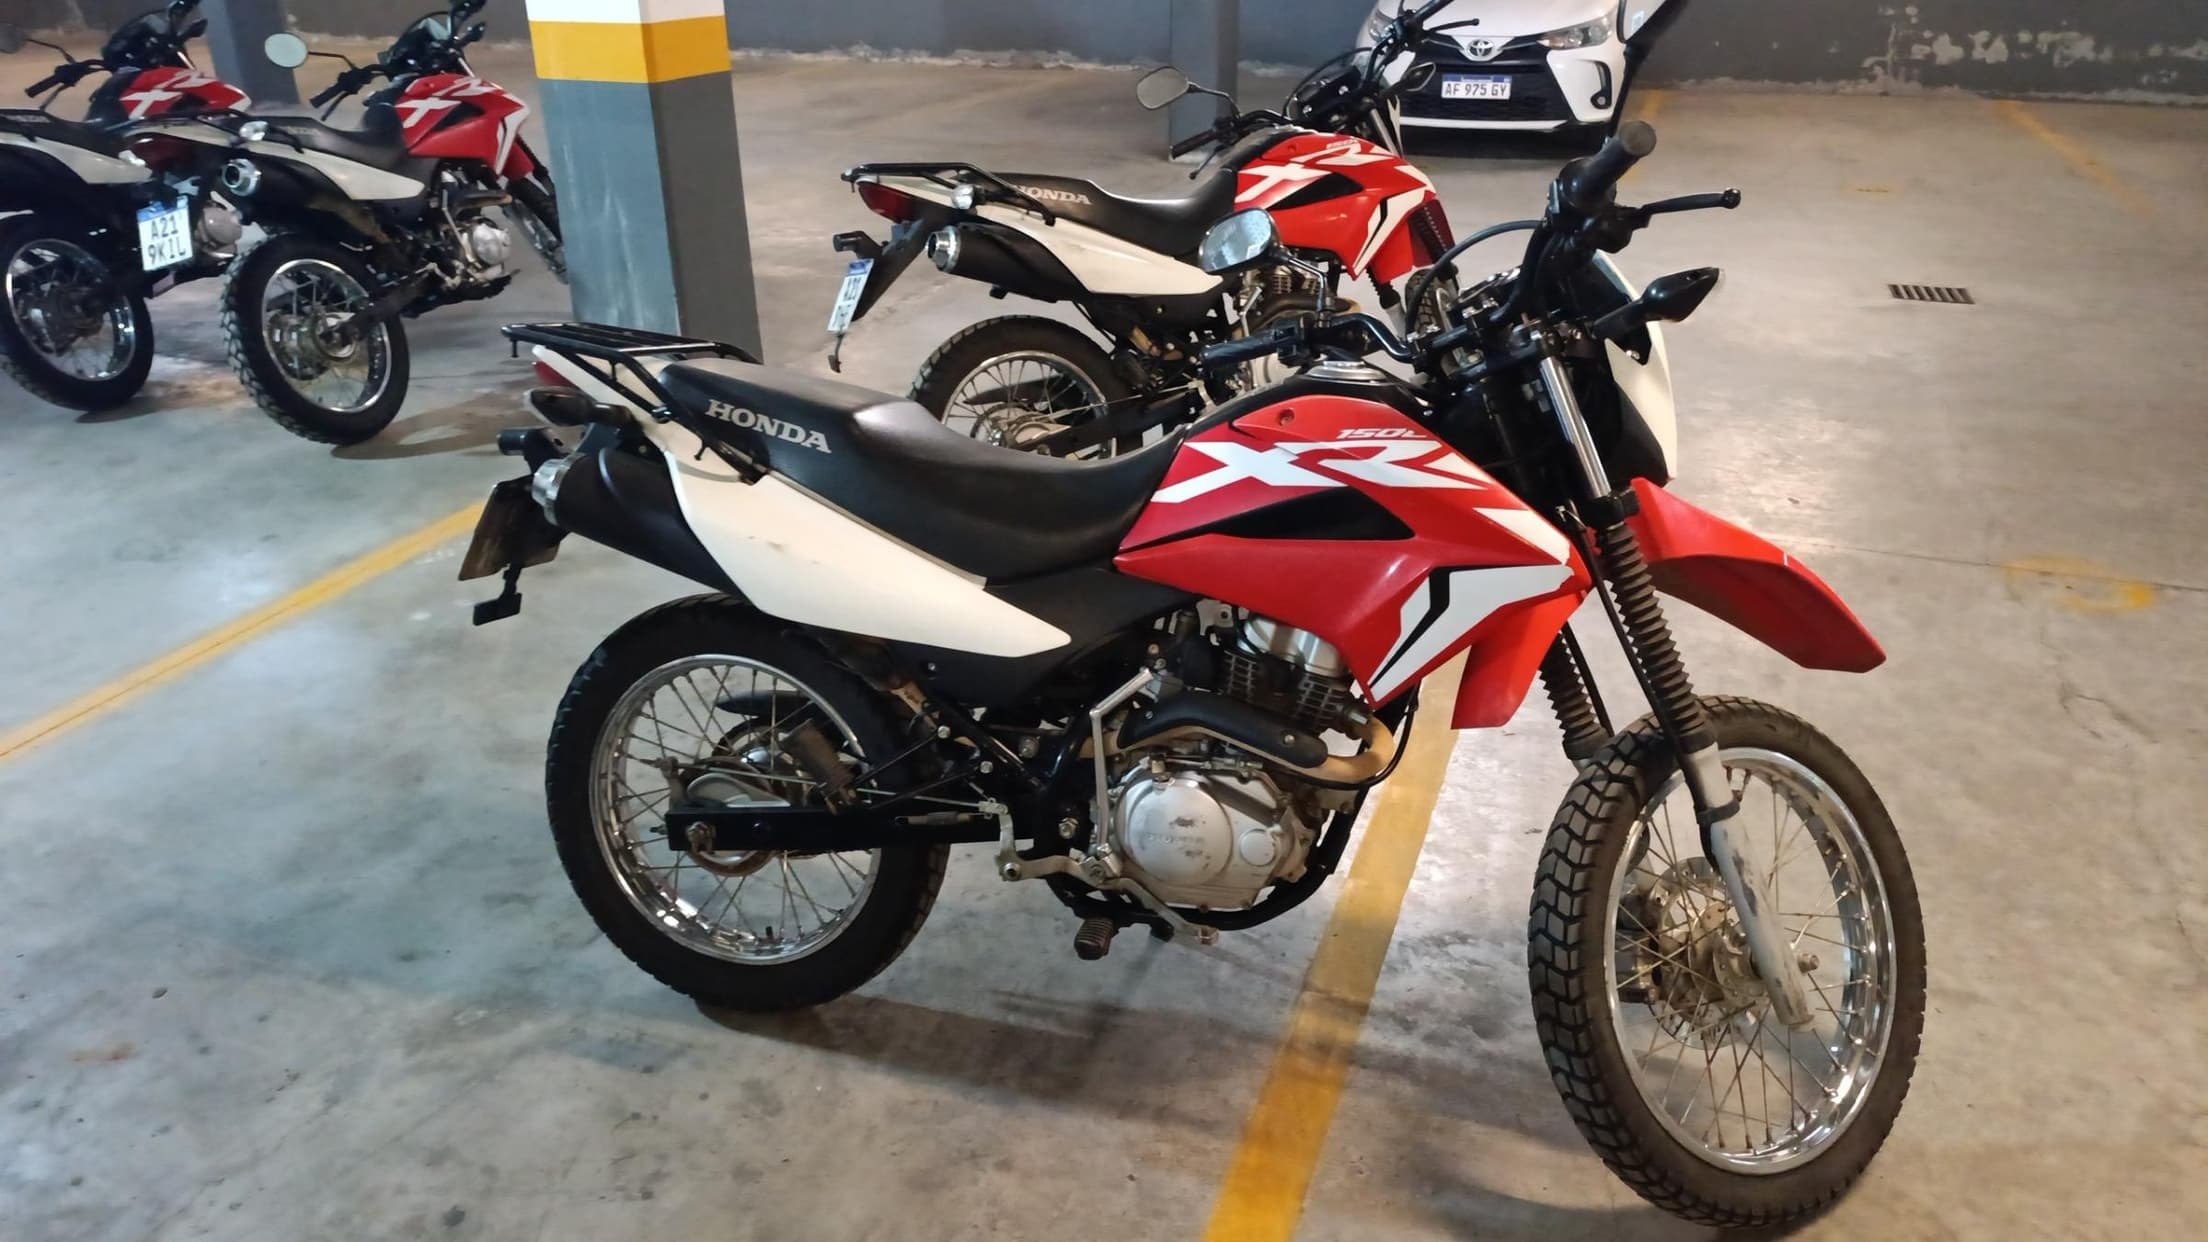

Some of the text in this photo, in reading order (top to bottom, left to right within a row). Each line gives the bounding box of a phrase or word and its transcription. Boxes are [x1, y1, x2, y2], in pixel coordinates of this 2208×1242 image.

[1444, 83, 1507, 97] AF 975 GY
[1234, 142, 1395, 203] XR
[151, 213, 180, 240] A21
[704, 398, 832, 454] HONDA
[1335, 427, 1428, 440] 150L
[1150, 439, 1489, 503] XR
